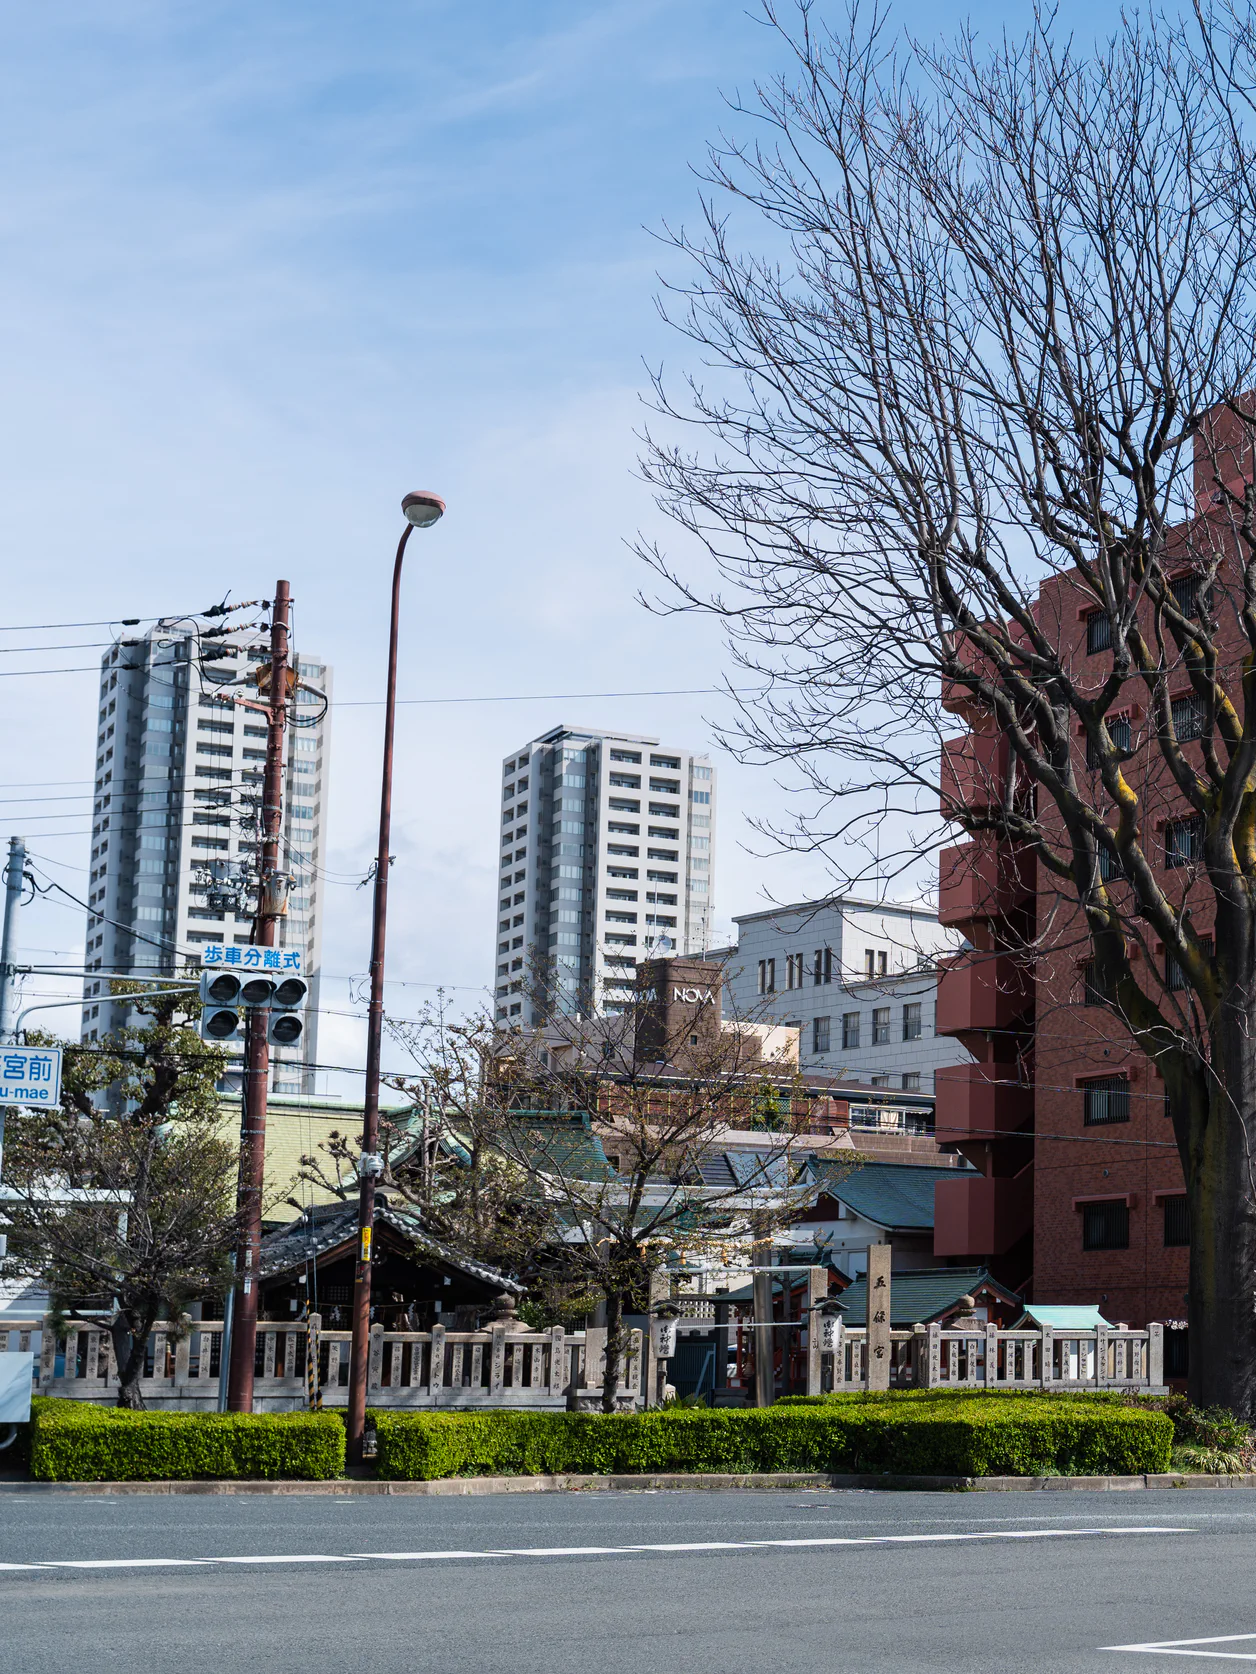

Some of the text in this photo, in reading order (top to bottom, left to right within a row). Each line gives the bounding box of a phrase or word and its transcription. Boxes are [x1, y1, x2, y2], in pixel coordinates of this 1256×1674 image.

[204, 945, 301, 970] 歩車分離式
[673, 986, 716, 1005] NOVA
[0, 1053, 52, 1082] 宮前
[873, 1275, 887, 1359] 五條宮
